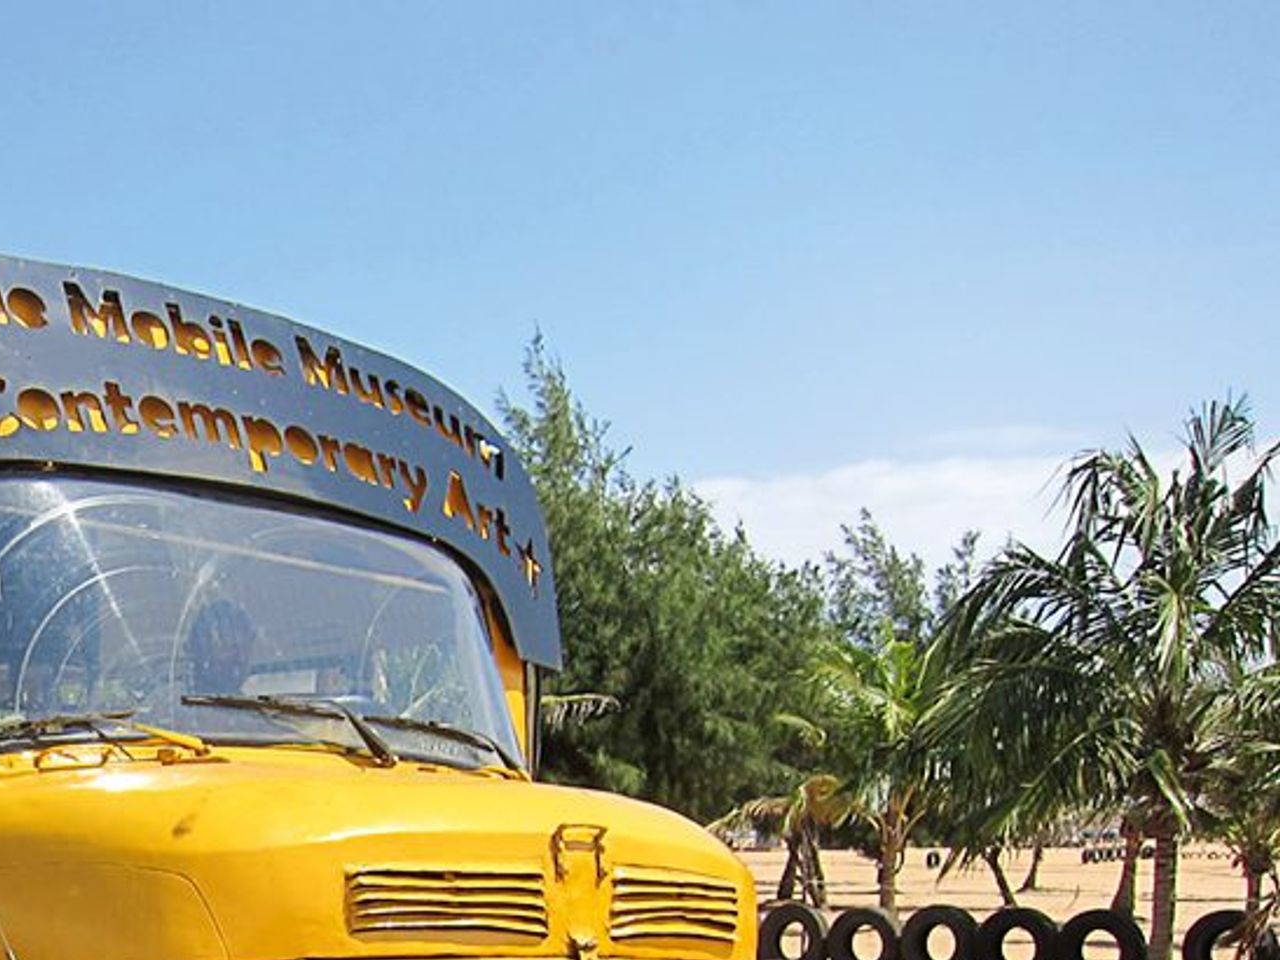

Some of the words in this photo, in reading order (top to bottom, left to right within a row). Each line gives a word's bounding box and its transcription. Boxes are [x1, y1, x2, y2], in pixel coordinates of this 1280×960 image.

[62, 281, 285, 376] Mobile
[295, 335, 505, 481] Museum
[443, 470, 511, 557] Art
